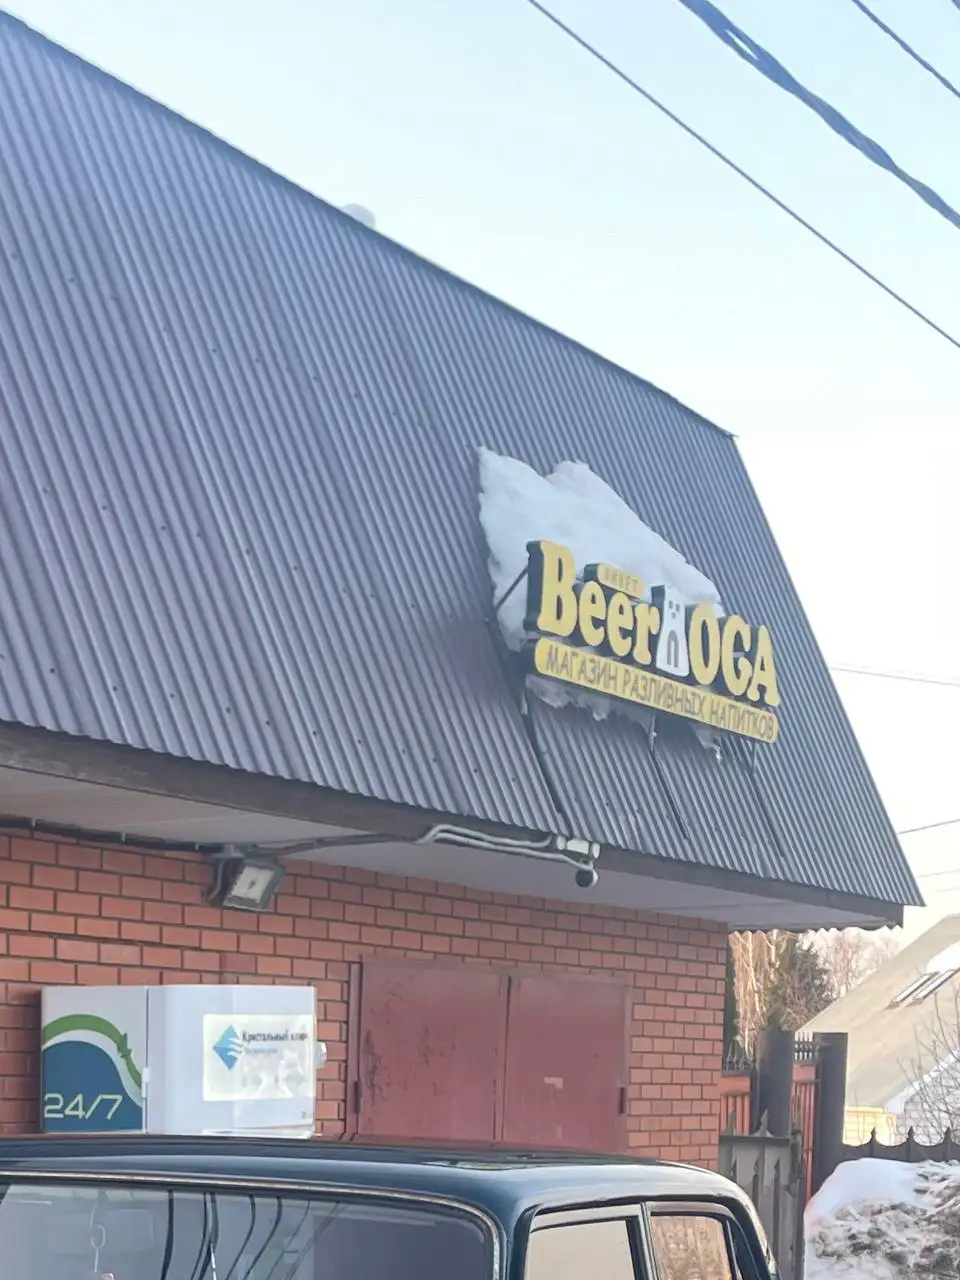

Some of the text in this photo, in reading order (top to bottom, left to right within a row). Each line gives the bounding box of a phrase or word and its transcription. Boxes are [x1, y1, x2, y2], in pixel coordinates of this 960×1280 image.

[545, 643, 775, 740] МАГАЗИН РАЗЛИВНЫХ НАПИТКОВ
[44, 1092, 123, 1121] 24/7
